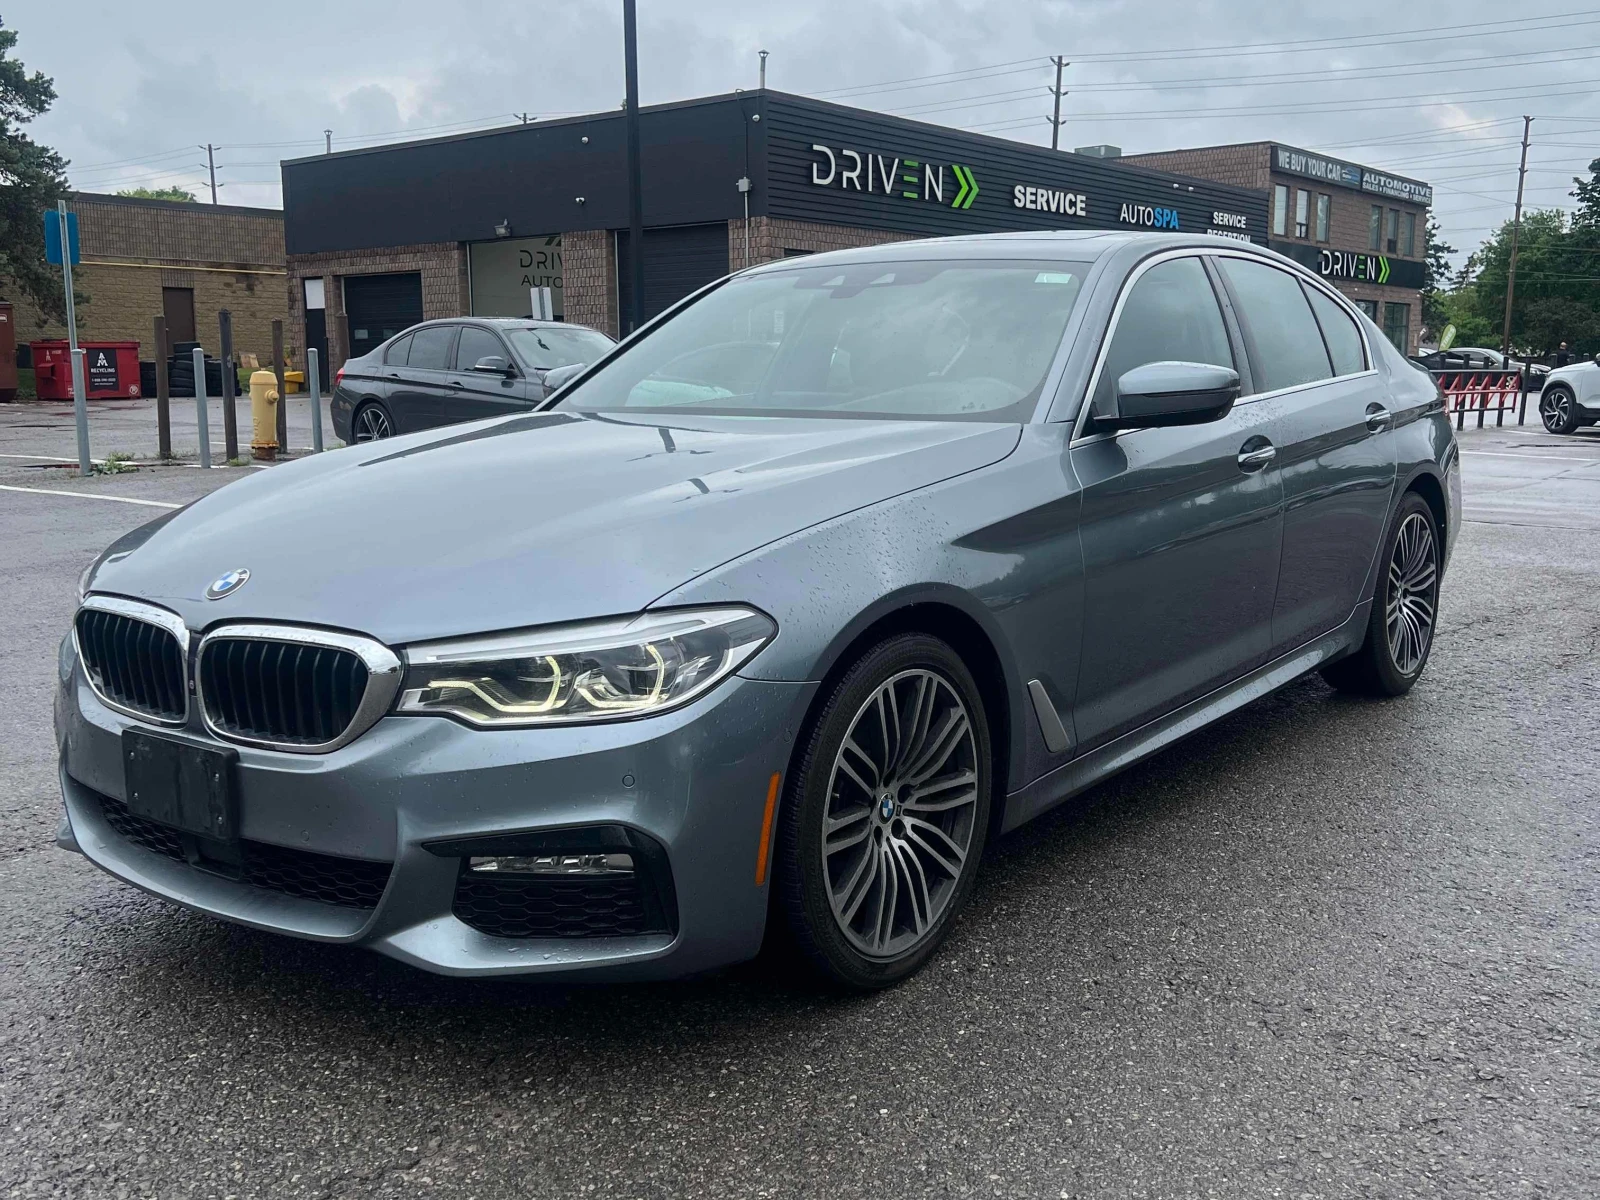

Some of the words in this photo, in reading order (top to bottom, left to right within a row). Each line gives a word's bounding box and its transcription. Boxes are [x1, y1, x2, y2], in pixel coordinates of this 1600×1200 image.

[812, 144, 943, 202] DRIVEN
[1278, 149, 1290, 169] WE
[1291, 153, 1307, 173] BUY
[1308, 157, 1326, 178] YOUR
[1327, 162, 1341, 181] CAR
[1362, 172, 1432, 198] AUTOMOTIVE
[1362, 182, 1379, 192] SALES
[1383, 187, 1410, 199] FINANCING
[1013, 184, 1087, 217] SERVICE
[1212, 211, 1247, 229] SERVICE
[1321, 249, 1376, 281] DRIVEN
[521, 274, 563, 289] AUTO
